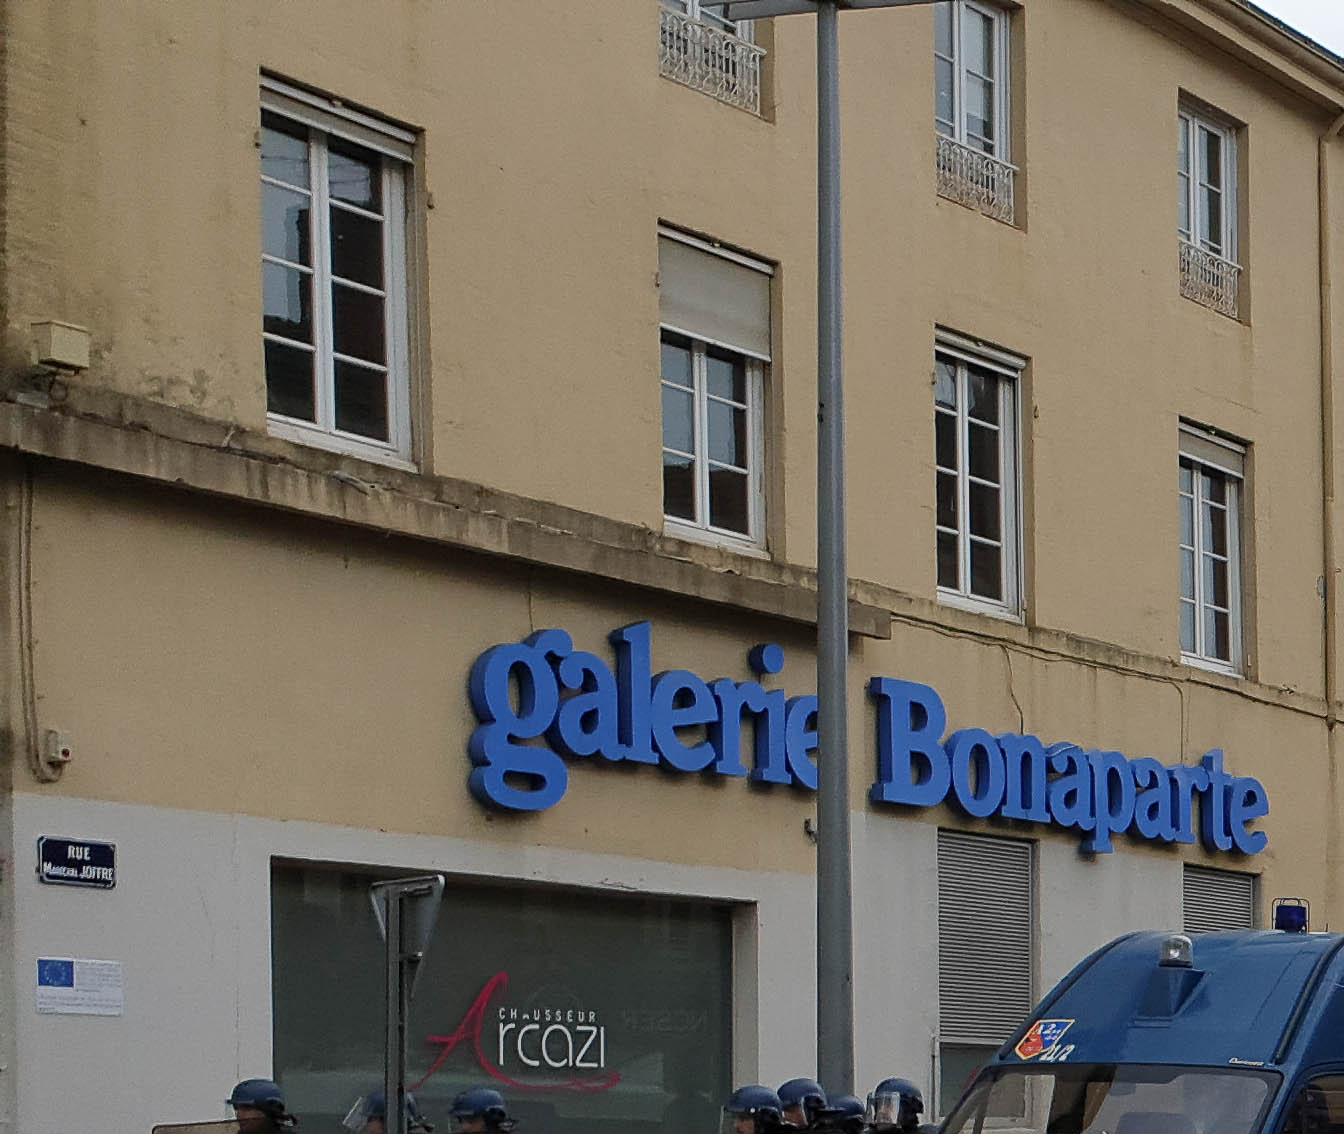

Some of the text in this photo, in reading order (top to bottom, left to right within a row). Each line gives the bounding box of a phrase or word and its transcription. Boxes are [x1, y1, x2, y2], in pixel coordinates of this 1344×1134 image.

[467, 620, 1269, 855] galerie Bonaparte
[67, 845, 91, 860] RUE
[498, 1007, 597, 1022] CHAUSSEUR
